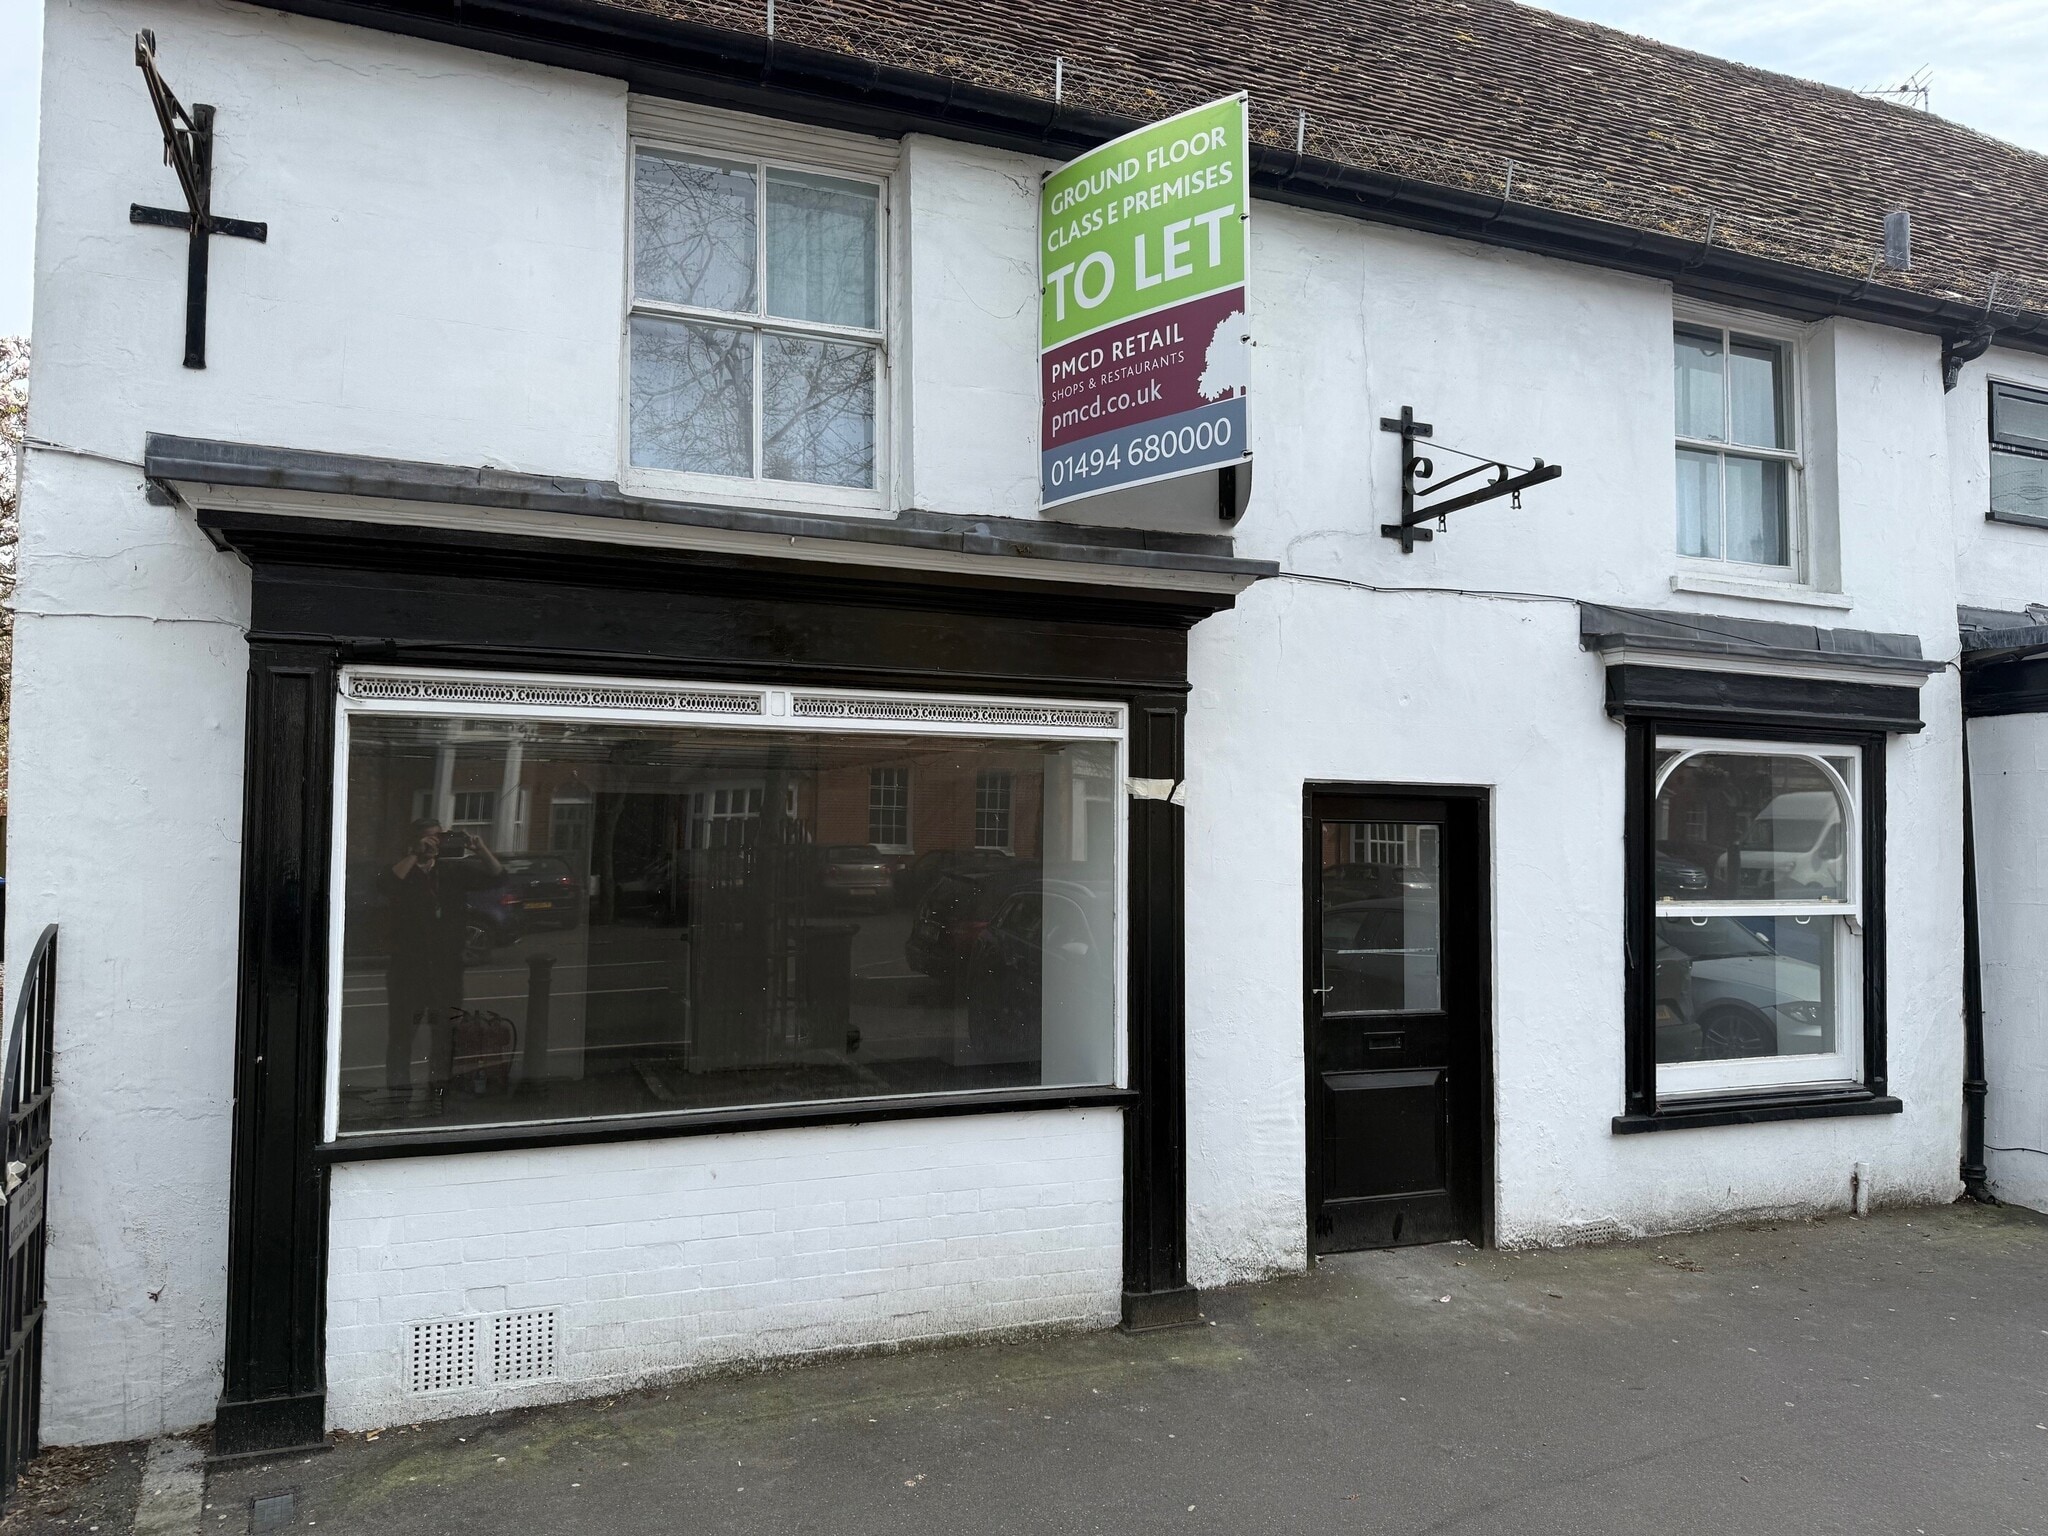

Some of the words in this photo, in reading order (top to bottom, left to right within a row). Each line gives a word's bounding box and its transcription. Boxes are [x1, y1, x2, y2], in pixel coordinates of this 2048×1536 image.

[1051, 158, 1140, 215] GROUND
[1147, 126, 1227, 173] FLOOR
[1048, 208, 1103, 252] CLASS
[1107, 201, 1119, 225] E
[1123, 161, 1233, 219] PREMISES
[1047, 251, 1115, 322] TO
[1135, 204, 1236, 291] LET
[1051, 381, 1085, 403] SHOPS
[1088, 377, 1097, 390] &
[1101, 350, 1185, 385] RESTAURANTS
[1052, 348, 1104, 384] PMCD
[1112, 323, 1184, 362] RETAIL
[1052, 378, 1163, 438] pmcd.co.uk
[1051, 443, 1121, 487] 01494
[1127, 417, 1232, 466] 680000
